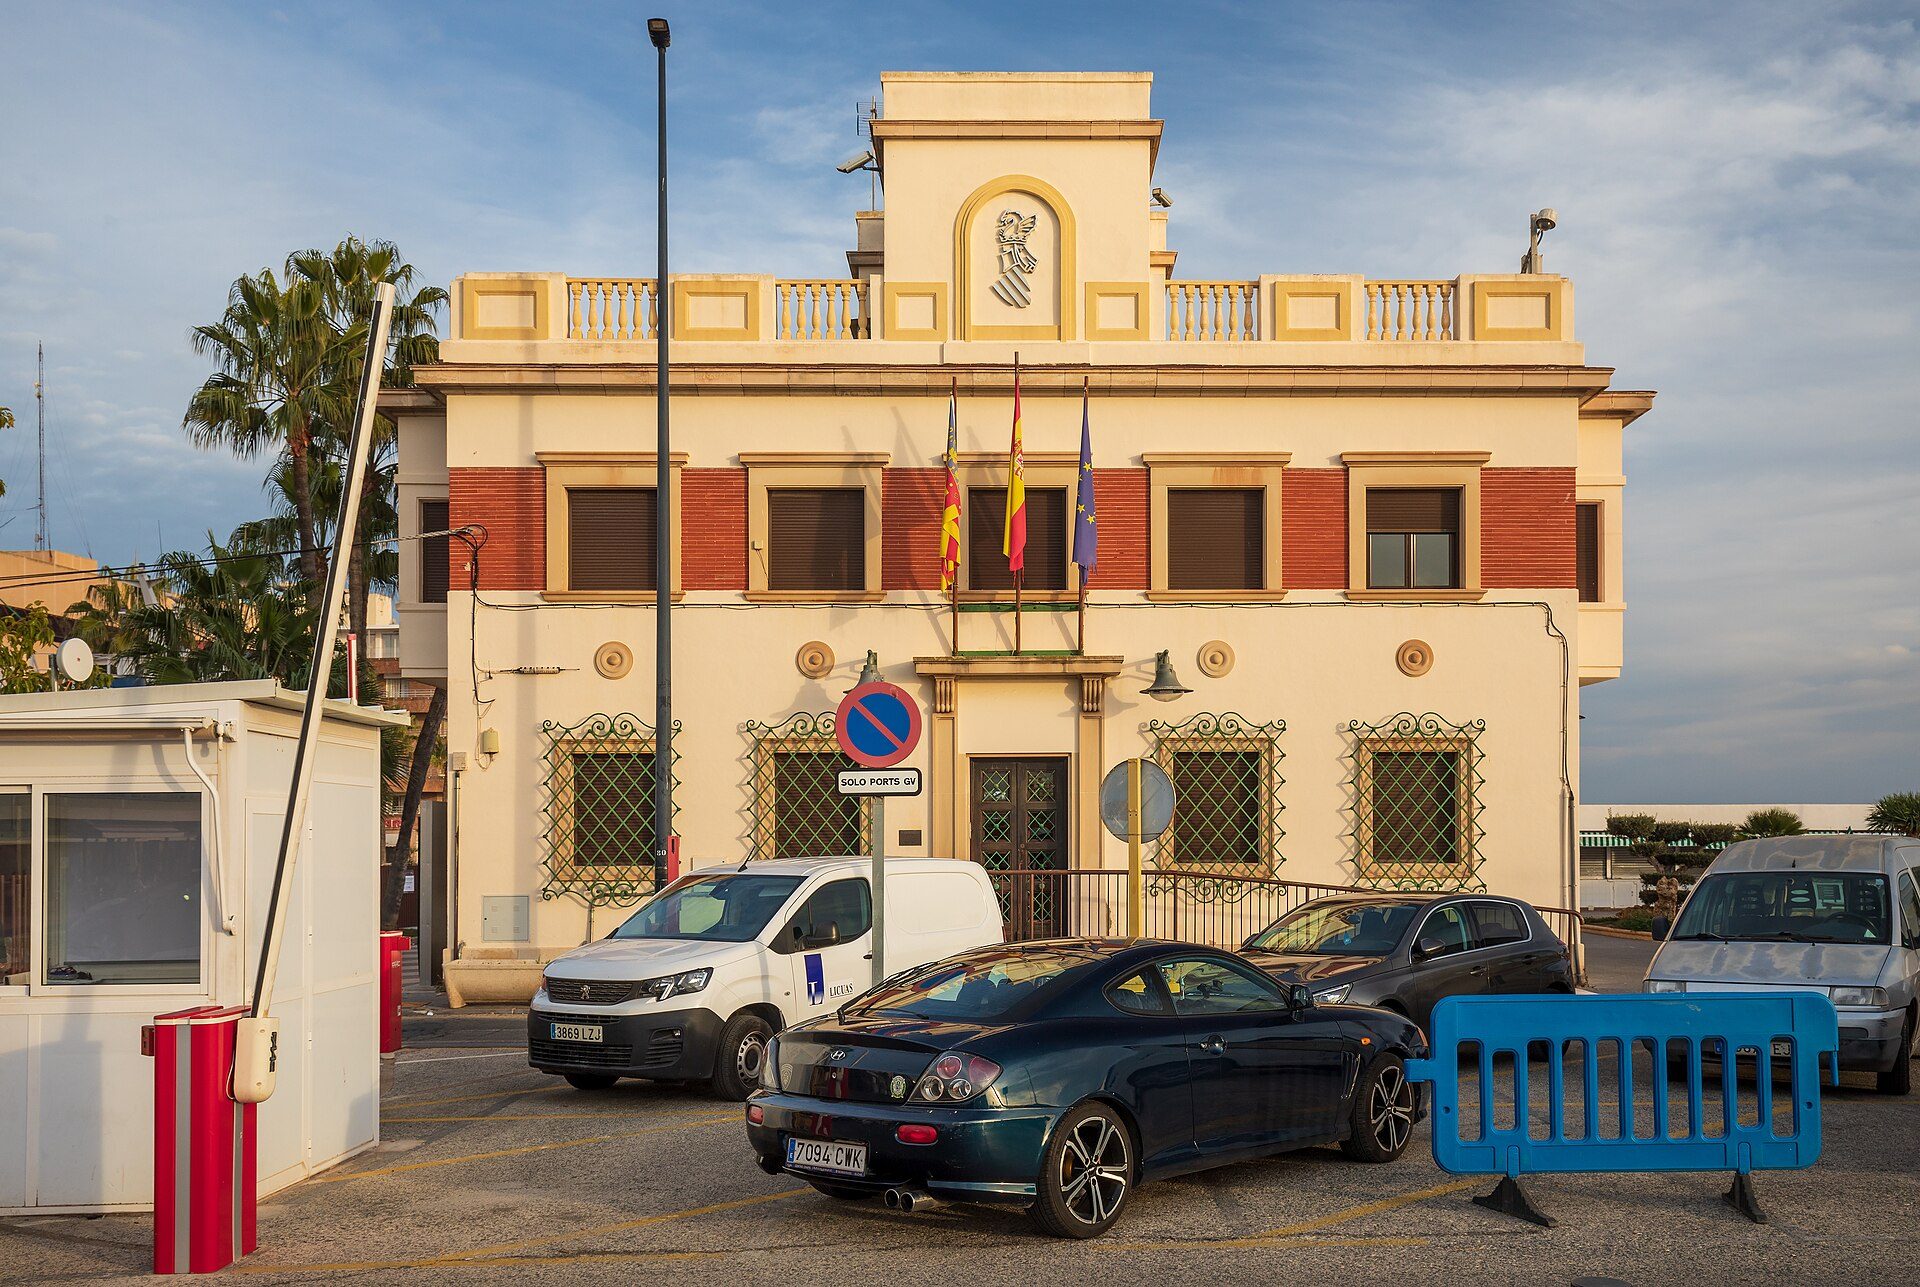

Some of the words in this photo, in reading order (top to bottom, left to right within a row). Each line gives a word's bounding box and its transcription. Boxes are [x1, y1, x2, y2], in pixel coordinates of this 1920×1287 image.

[841, 778, 867, 787] SOLO
[870, 777, 900, 786] PORTS
[903, 777, 916, 786] GV
[829, 982, 854, 997] LICUAS
[556, 1026, 580, 1040] 3869
[582, 1027, 601, 1041] LZJ
[796, 1142, 831, 1165] 7094
[835, 1146, 862, 1169] CWK
